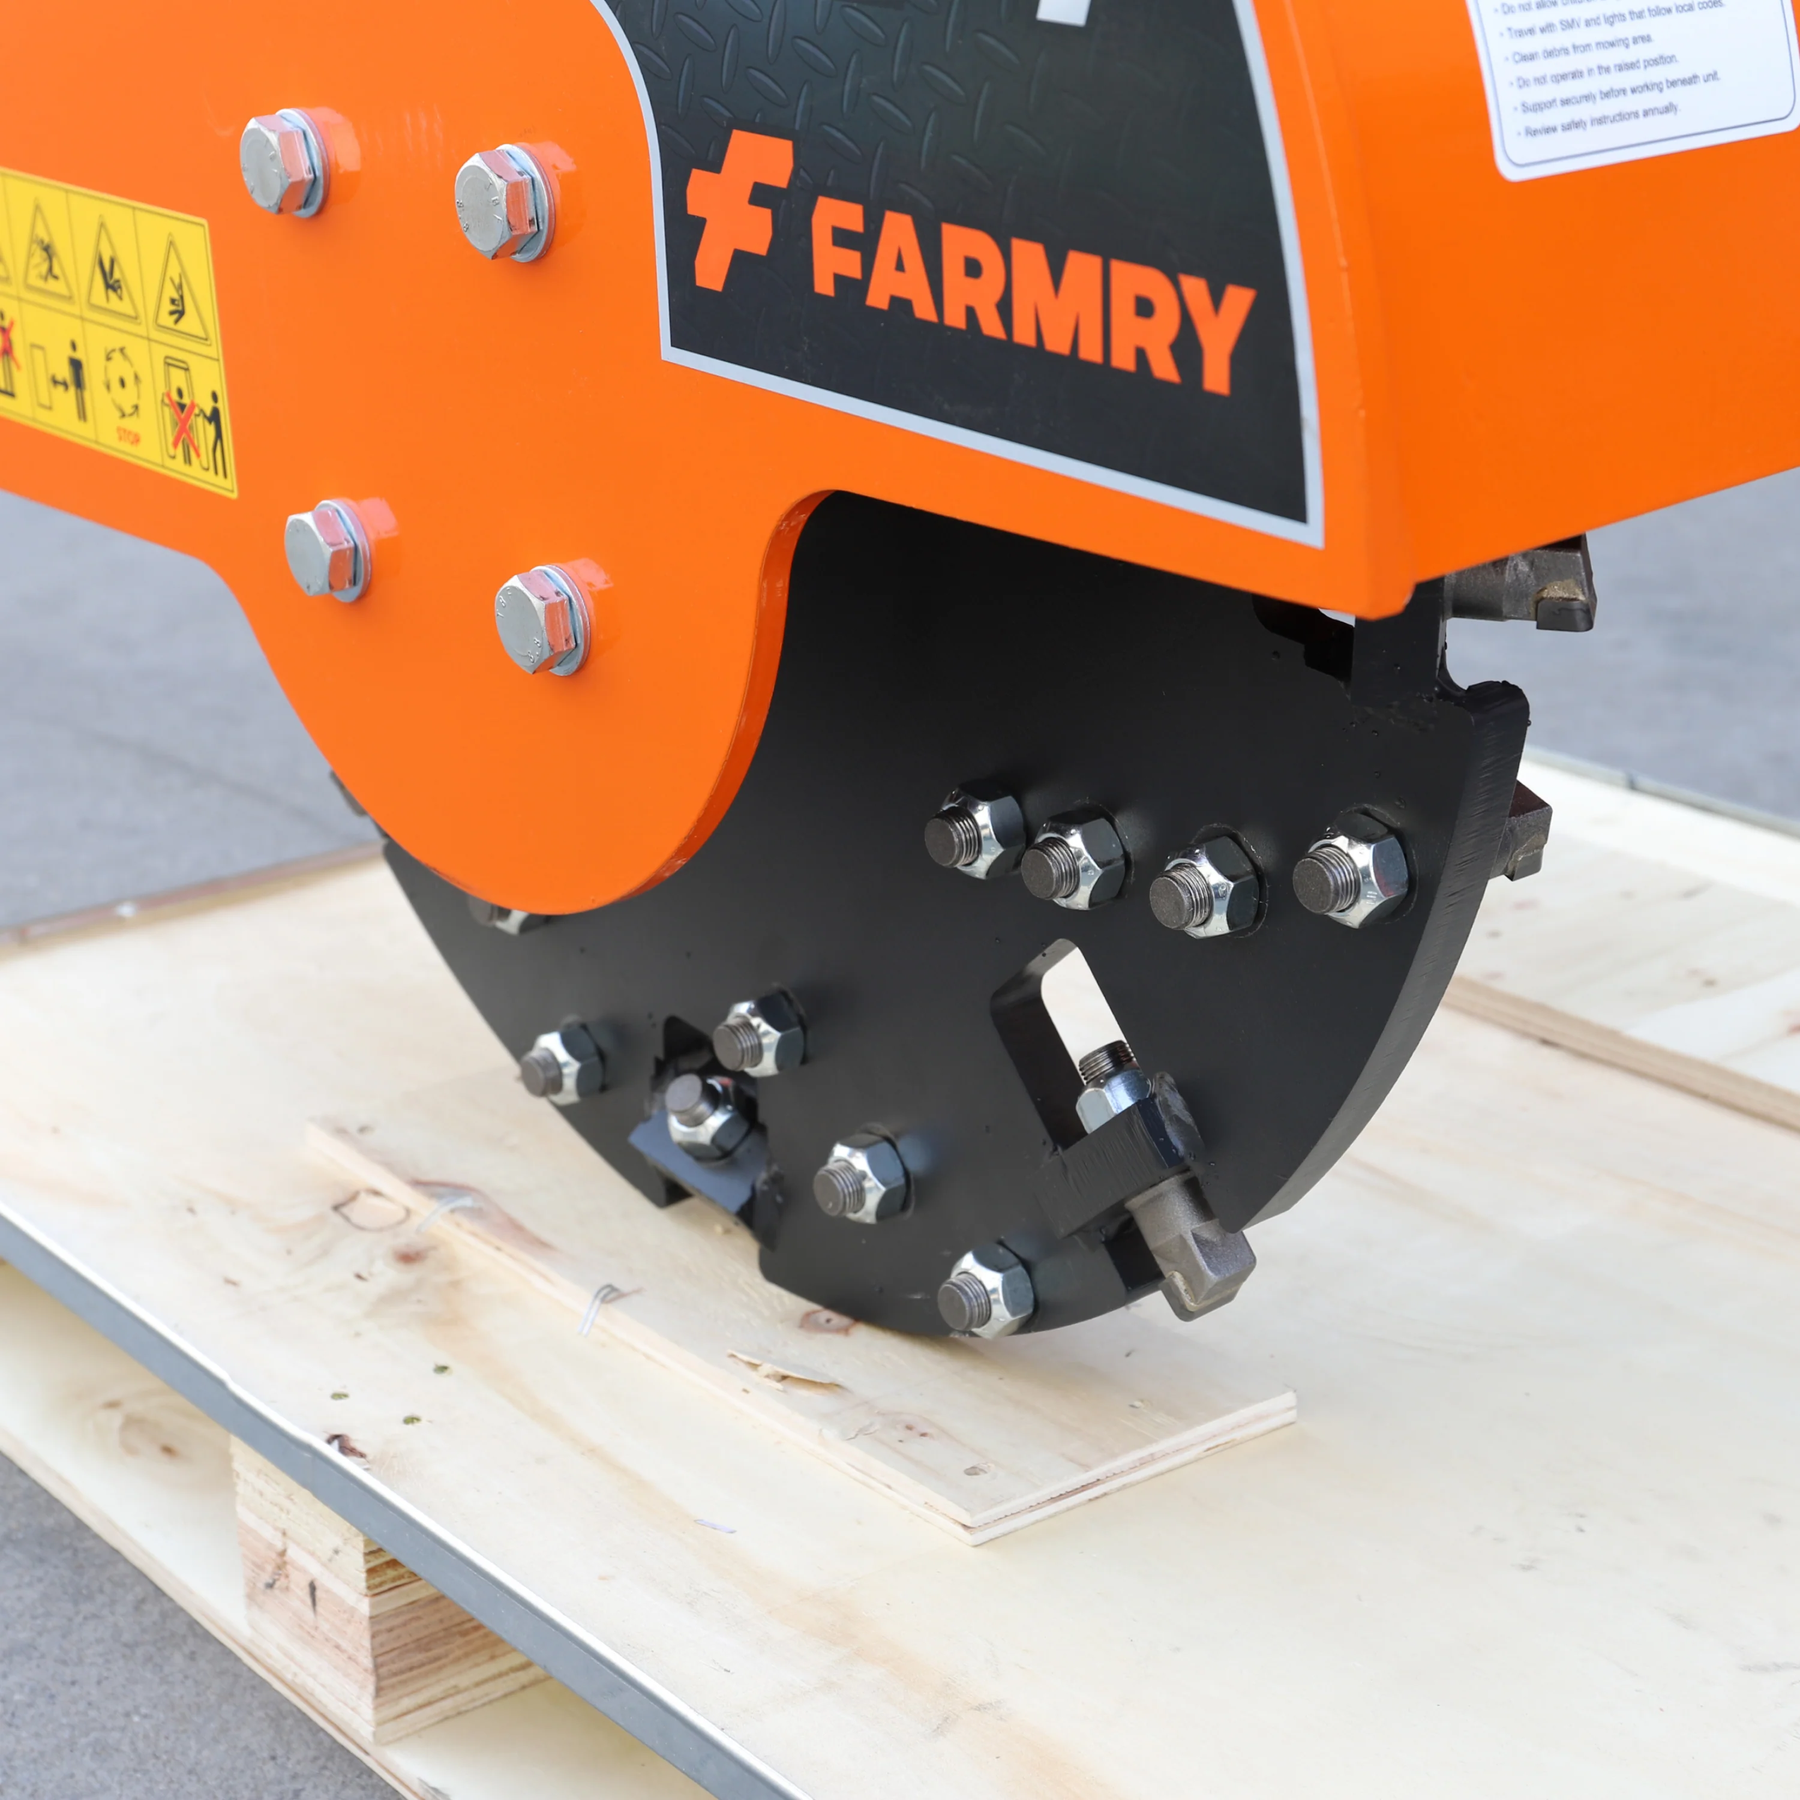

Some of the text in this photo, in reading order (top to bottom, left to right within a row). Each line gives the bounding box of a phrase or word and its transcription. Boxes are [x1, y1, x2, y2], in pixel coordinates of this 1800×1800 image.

[1501, 3, 1515, 15] Do
[1520, 1, 1533, 11] not
[1507, 26, 1536, 39] Travel
[1539, 21, 1557, 34] with
[1560, 17, 1581, 31] SMV
[1585, 14, 1601, 27] and
[1603, 11, 1627, 27] lights
[1629, 8, 1645, 20] that
[1647, 5, 1673, 18] follow
[1675, 2, 1694, 14] local
[1513, 50, 1540, 64] Clean
[1543, 45, 1570, 59] debris
[1573, 41, 1593, 54] from
[1596, 37, 1630, 50] mowing
[1517, 53, 1679, 89] Do not operate in the raised position.
[1522, 69, 1721, 114] Support securely before working beneath unit.
[1525, 125, 1558, 138] Review
[1561, 119, 1588, 131] safety
[1590, 109, 1640, 127] instructions
[811, 195, 1257, 396] FARMRY
[116, 425, 142, 448] STOP
